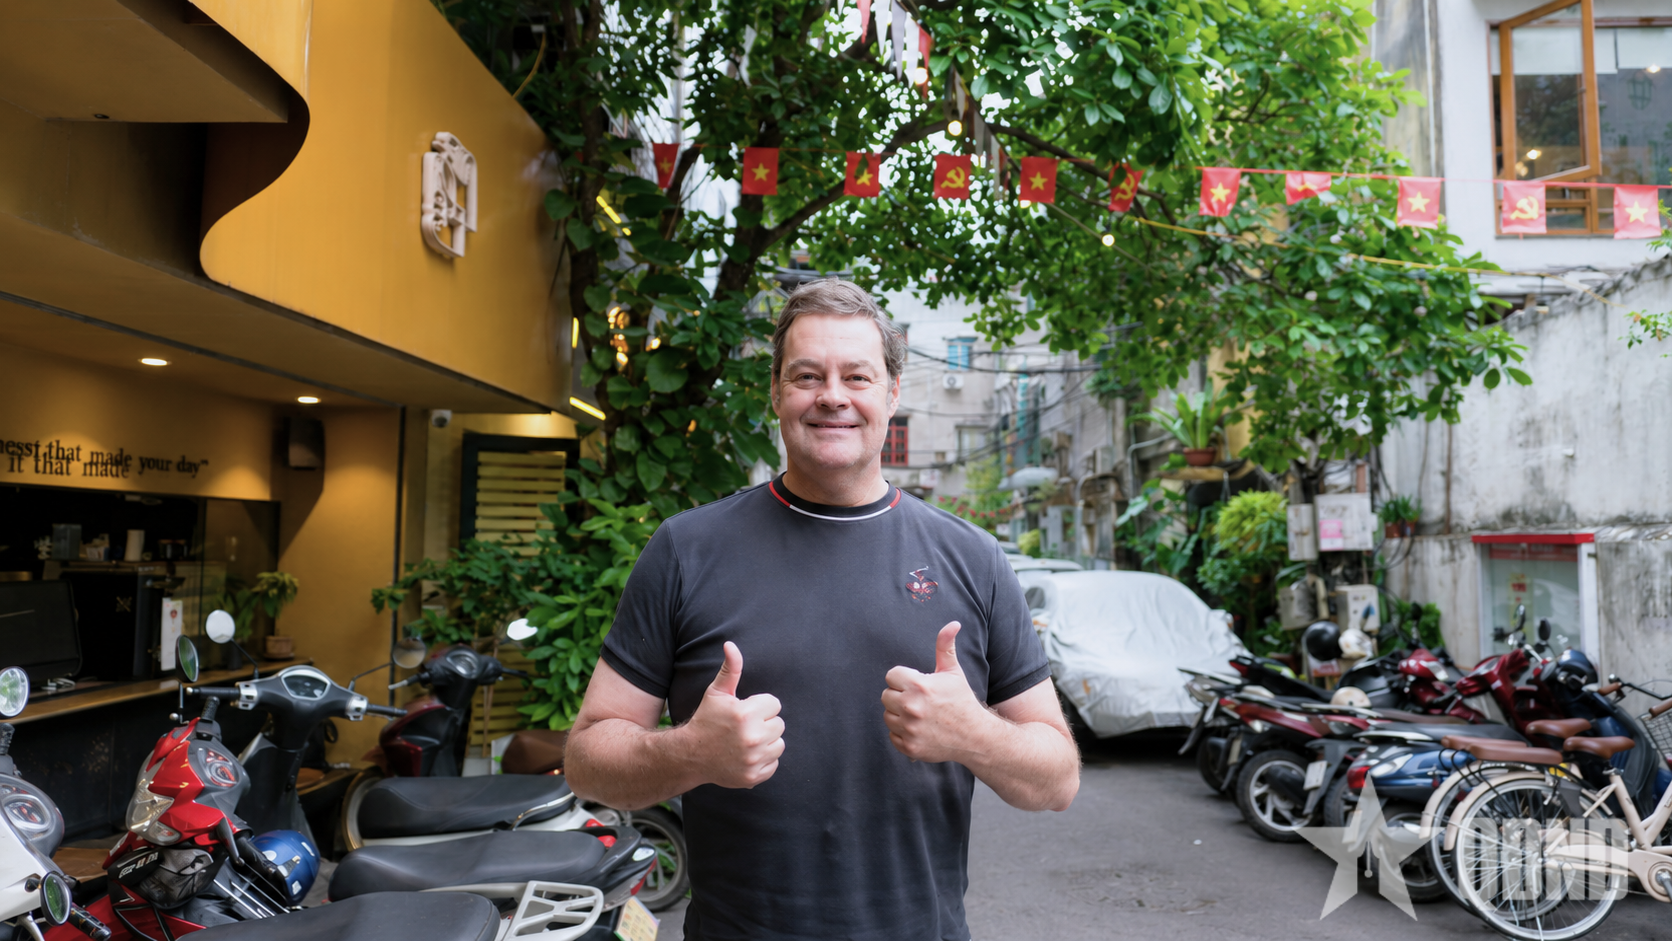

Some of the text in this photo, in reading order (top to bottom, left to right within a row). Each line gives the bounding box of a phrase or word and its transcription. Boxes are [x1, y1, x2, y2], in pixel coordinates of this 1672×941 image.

[34, 451, 72, 476] that
[45, 440, 82, 461] that
[90, 447, 132, 467] made
[138, 455, 173, 475] your
